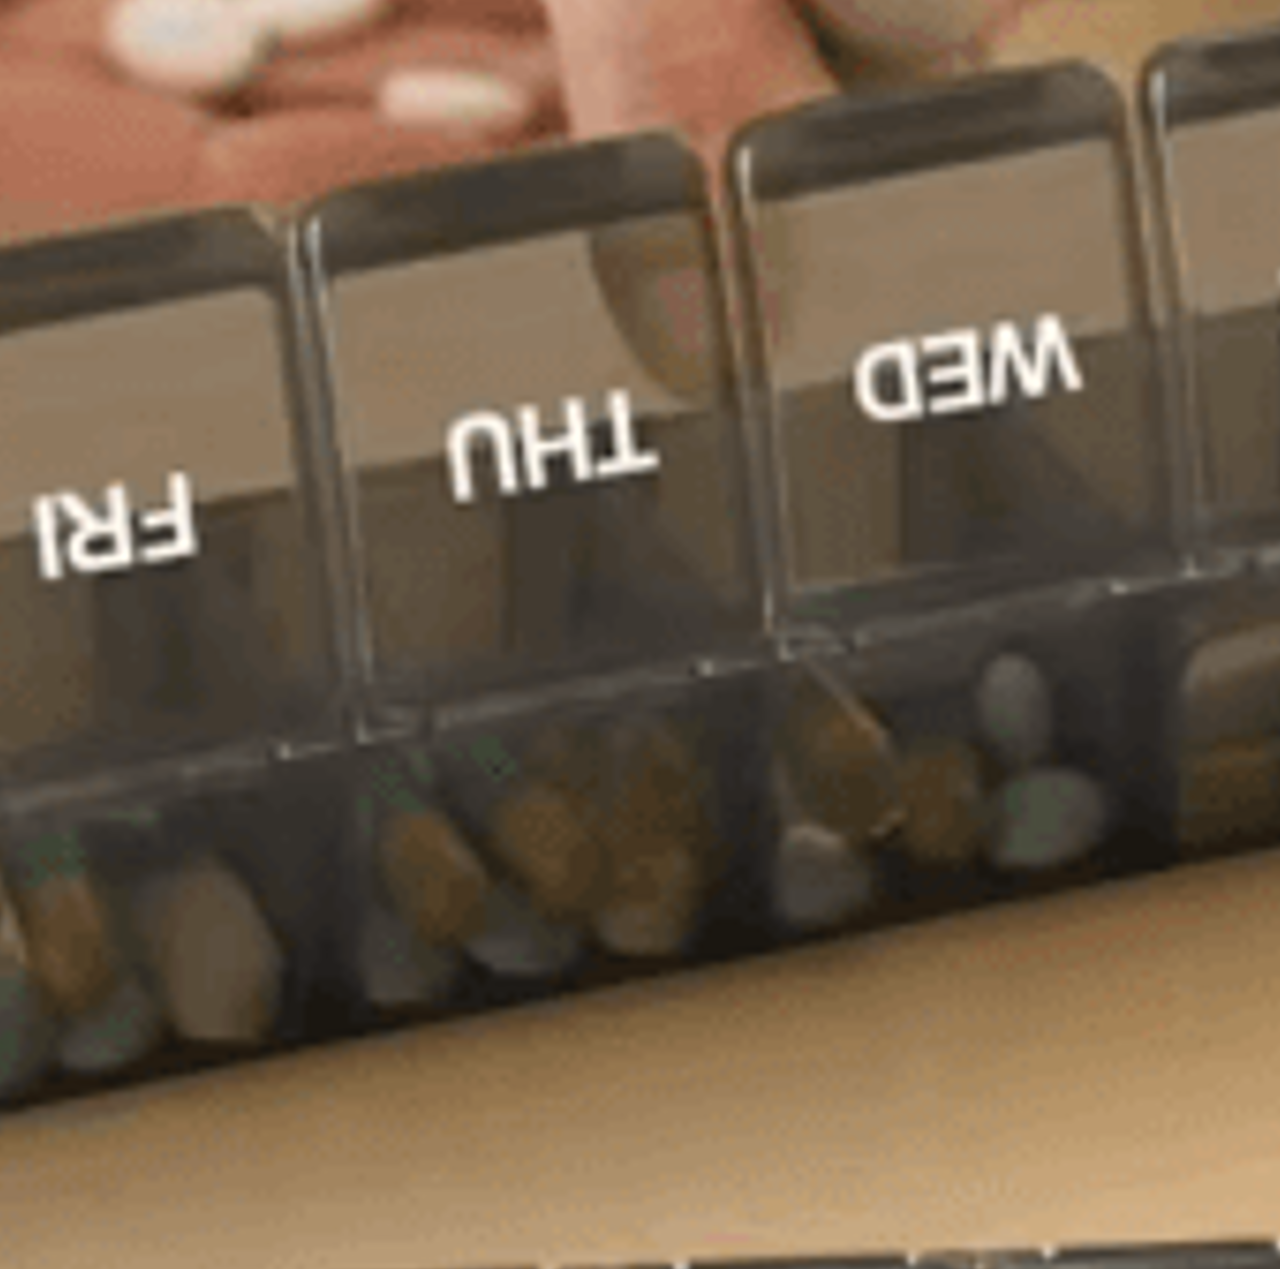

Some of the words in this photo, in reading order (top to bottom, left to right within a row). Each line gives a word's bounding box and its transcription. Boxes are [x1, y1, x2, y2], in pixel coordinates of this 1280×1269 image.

[854, 313, 1082, 424] WED
[445, 388, 659, 501] THU
[32, 471, 196, 580] FRI
